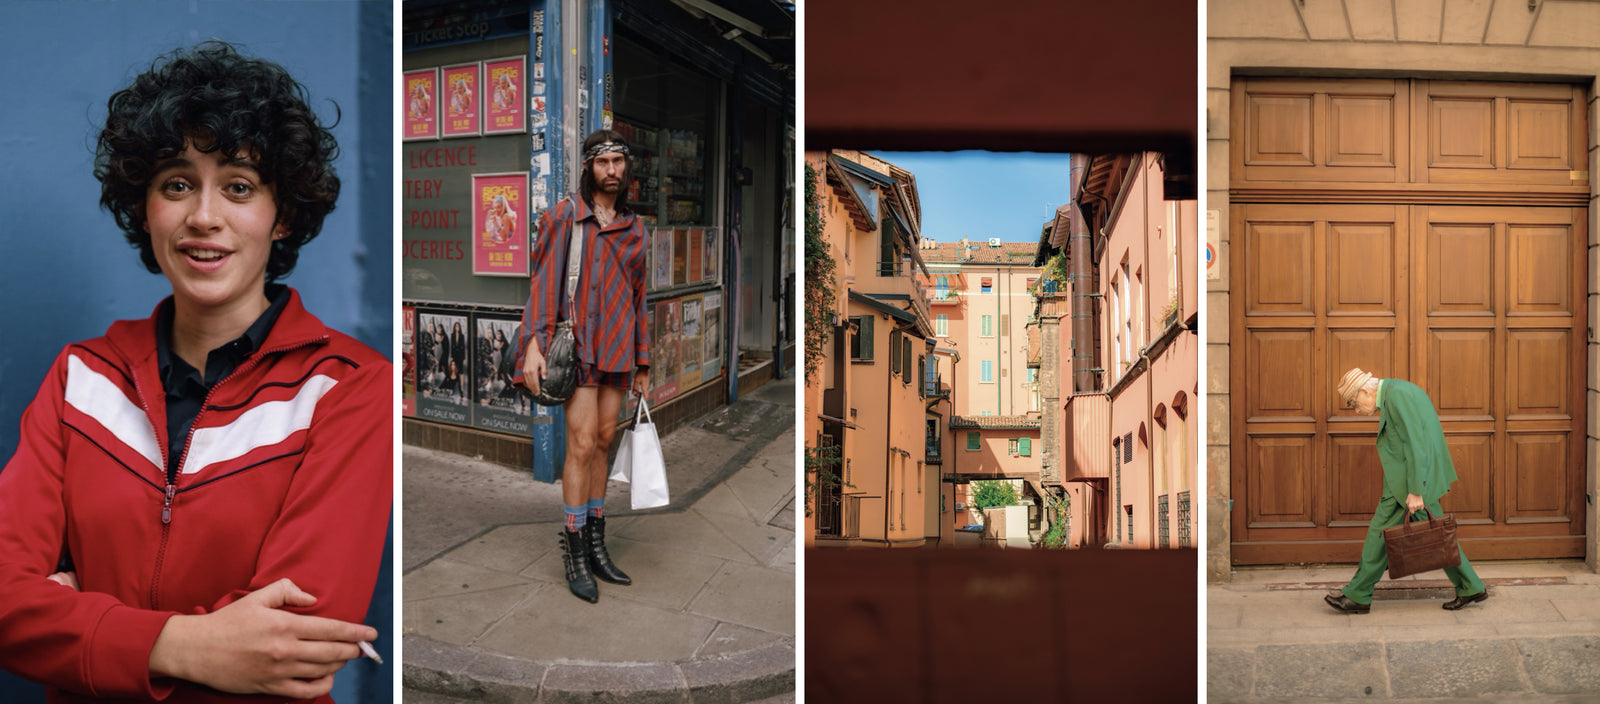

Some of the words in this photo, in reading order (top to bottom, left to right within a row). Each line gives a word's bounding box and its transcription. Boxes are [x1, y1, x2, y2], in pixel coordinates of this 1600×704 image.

[456, 22, 490, 40] Stop
[410, 145, 477, 168] LICENCE
[402, 178, 443, 199] TERY
